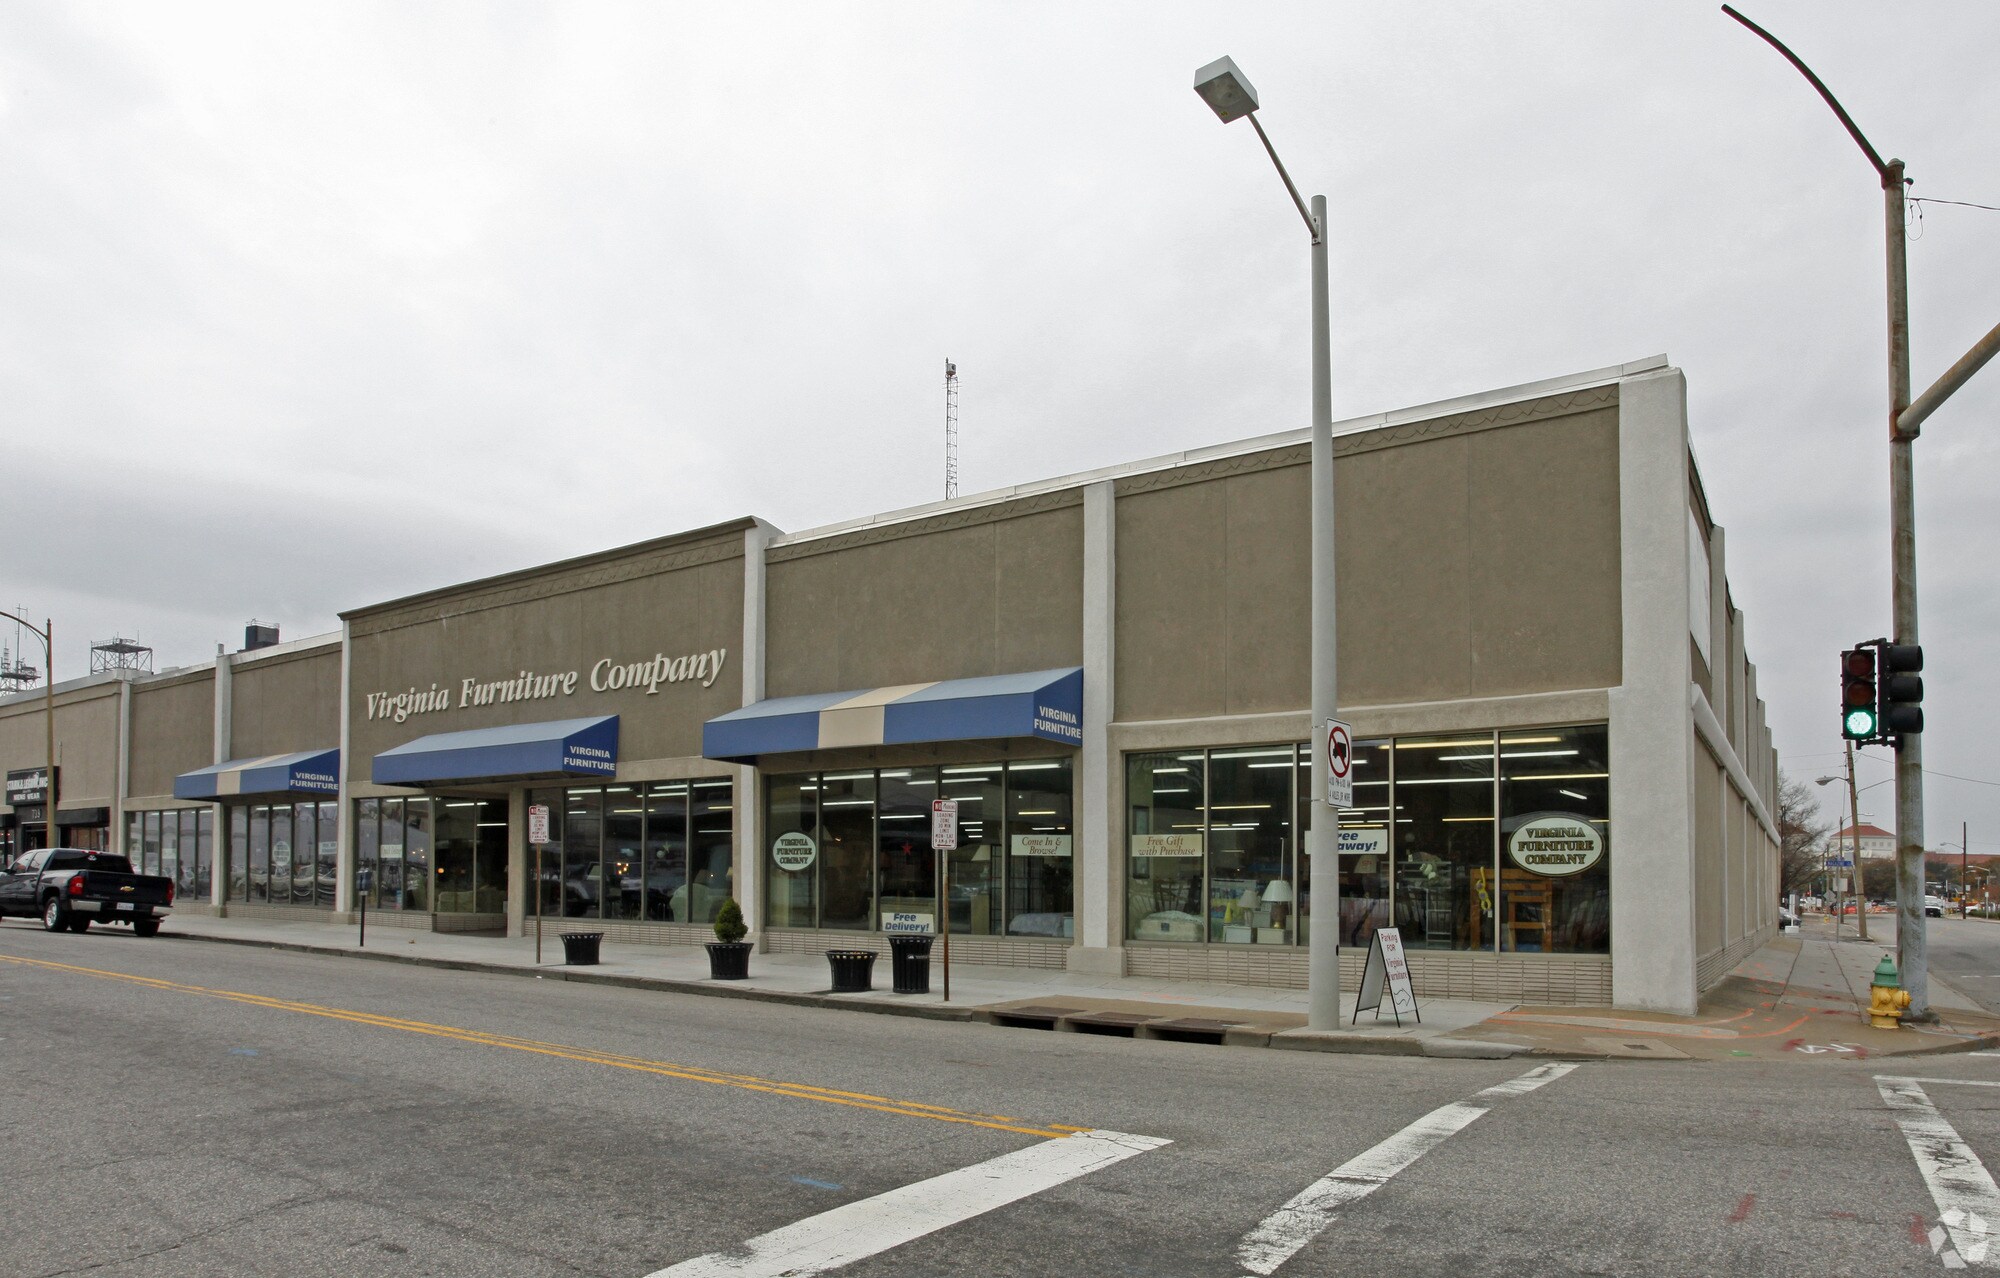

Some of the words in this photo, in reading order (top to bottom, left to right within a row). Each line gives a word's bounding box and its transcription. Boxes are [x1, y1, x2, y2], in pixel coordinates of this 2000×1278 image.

[367, 683, 450, 722] Virginia
[458, 670, 578, 708] Furniture
[590, 648, 727, 694] Company
[1039, 705, 1077, 724] VIRGINIA
[1034, 718, 1082, 739] FURNITURE
[570, 745, 610, 759] VIRGINIA
[564, 757, 616, 771] FURNITURE
[295, 771, 334, 782] VIRGINIA
[290, 779, 339, 790] FURNITURE
[1338, 832, 1358, 840] ree
[1526, 827, 1586, 838] VIRGINIA
[1022, 836, 1043, 846] Come
[1045, 837, 1052, 846] In
[1056, 836, 1062, 846] &
[1147, 836, 1164, 846] Free
[1166, 835, 1184, 848] Gift
[1338, 841, 1378, 852] away!
[1518, 840, 1594, 852] FURNITURE
[1029, 846, 1058, 854] Browse!
[1138, 846, 1158, 856] with
[1160, 846, 1196, 856] Purchase
[1525, 854, 1586, 864] COMPANY
[894, 913, 916, 922] Free
[885, 922, 930, 933] Delivery!
[1380, 932, 1398, 944] Parking
[1386, 957, 1403, 968] Virginia
